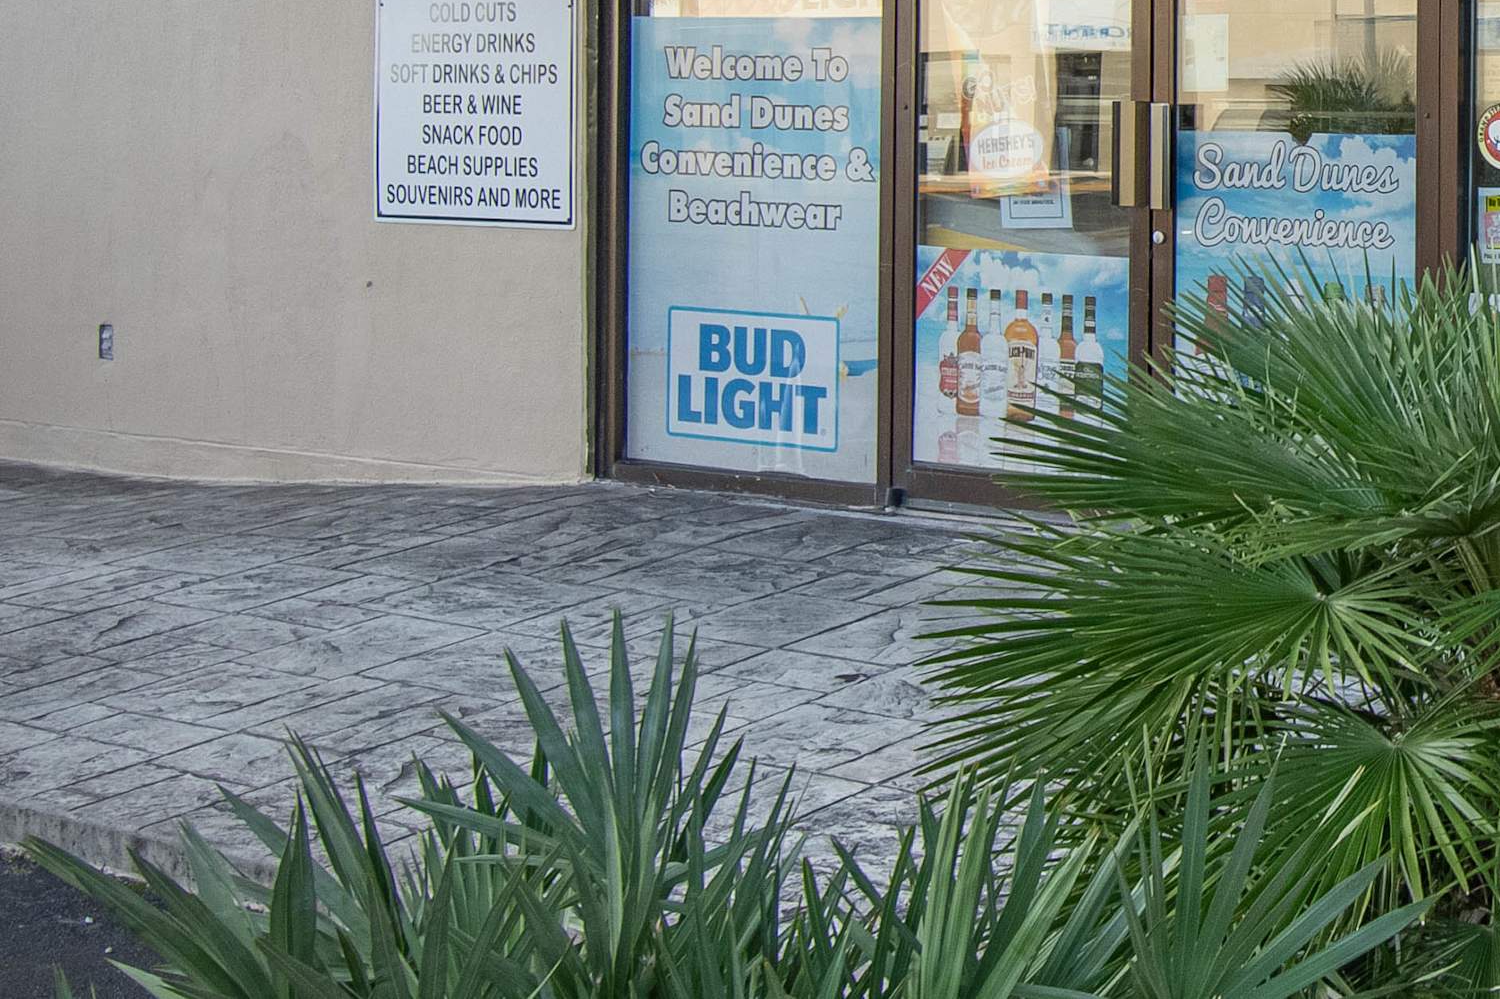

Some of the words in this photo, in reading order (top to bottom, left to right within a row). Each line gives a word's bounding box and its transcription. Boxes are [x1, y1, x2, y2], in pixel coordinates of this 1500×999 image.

[430, 2, 471, 23] COLD
[475, 1, 517, 23] CUTS
[411, 33, 472, 53] ENERGY
[476, 32, 536, 53] DRINKS
[390, 63, 429, 84] SOFT
[433, 64, 490, 84] DRINKS
[494, 64, 506, 84] &
[509, 64, 558, 85] CHIPS
[664, 45, 803, 82] Welcome
[812, 47, 849, 83] To
[423, 94, 463, 114] BEER
[467, 94, 478, 114] &
[482, 94, 522, 115] WINE
[663, 93, 741, 129] Sand
[750, 95, 849, 132] Dunes
[422, 124, 474, 145] SNACK
[479, 125, 523, 145] FOOD
[977, 132, 1034, 154] HERSHEY'S
[407, 154, 459, 175] BEACH
[463, 156, 538, 178] SUPPLIES
[640, 140, 837, 181] Convenience
[845, 147, 876, 183] &
[1192, 140, 1287, 191] Sand
[1289, 145, 1400, 193] Dunes
[387, 183, 474, 206] SOUVENIRS
[477, 186, 511, 208] AND
[515, 188, 561, 210] MORE
[668, 189, 842, 230] Beachwear
[1195, 196, 1395, 250] Convenience
[920, 253, 955, 299] NEW
[699, 323, 807, 379] BUD
[677, 373, 828, 437] LIGHT
